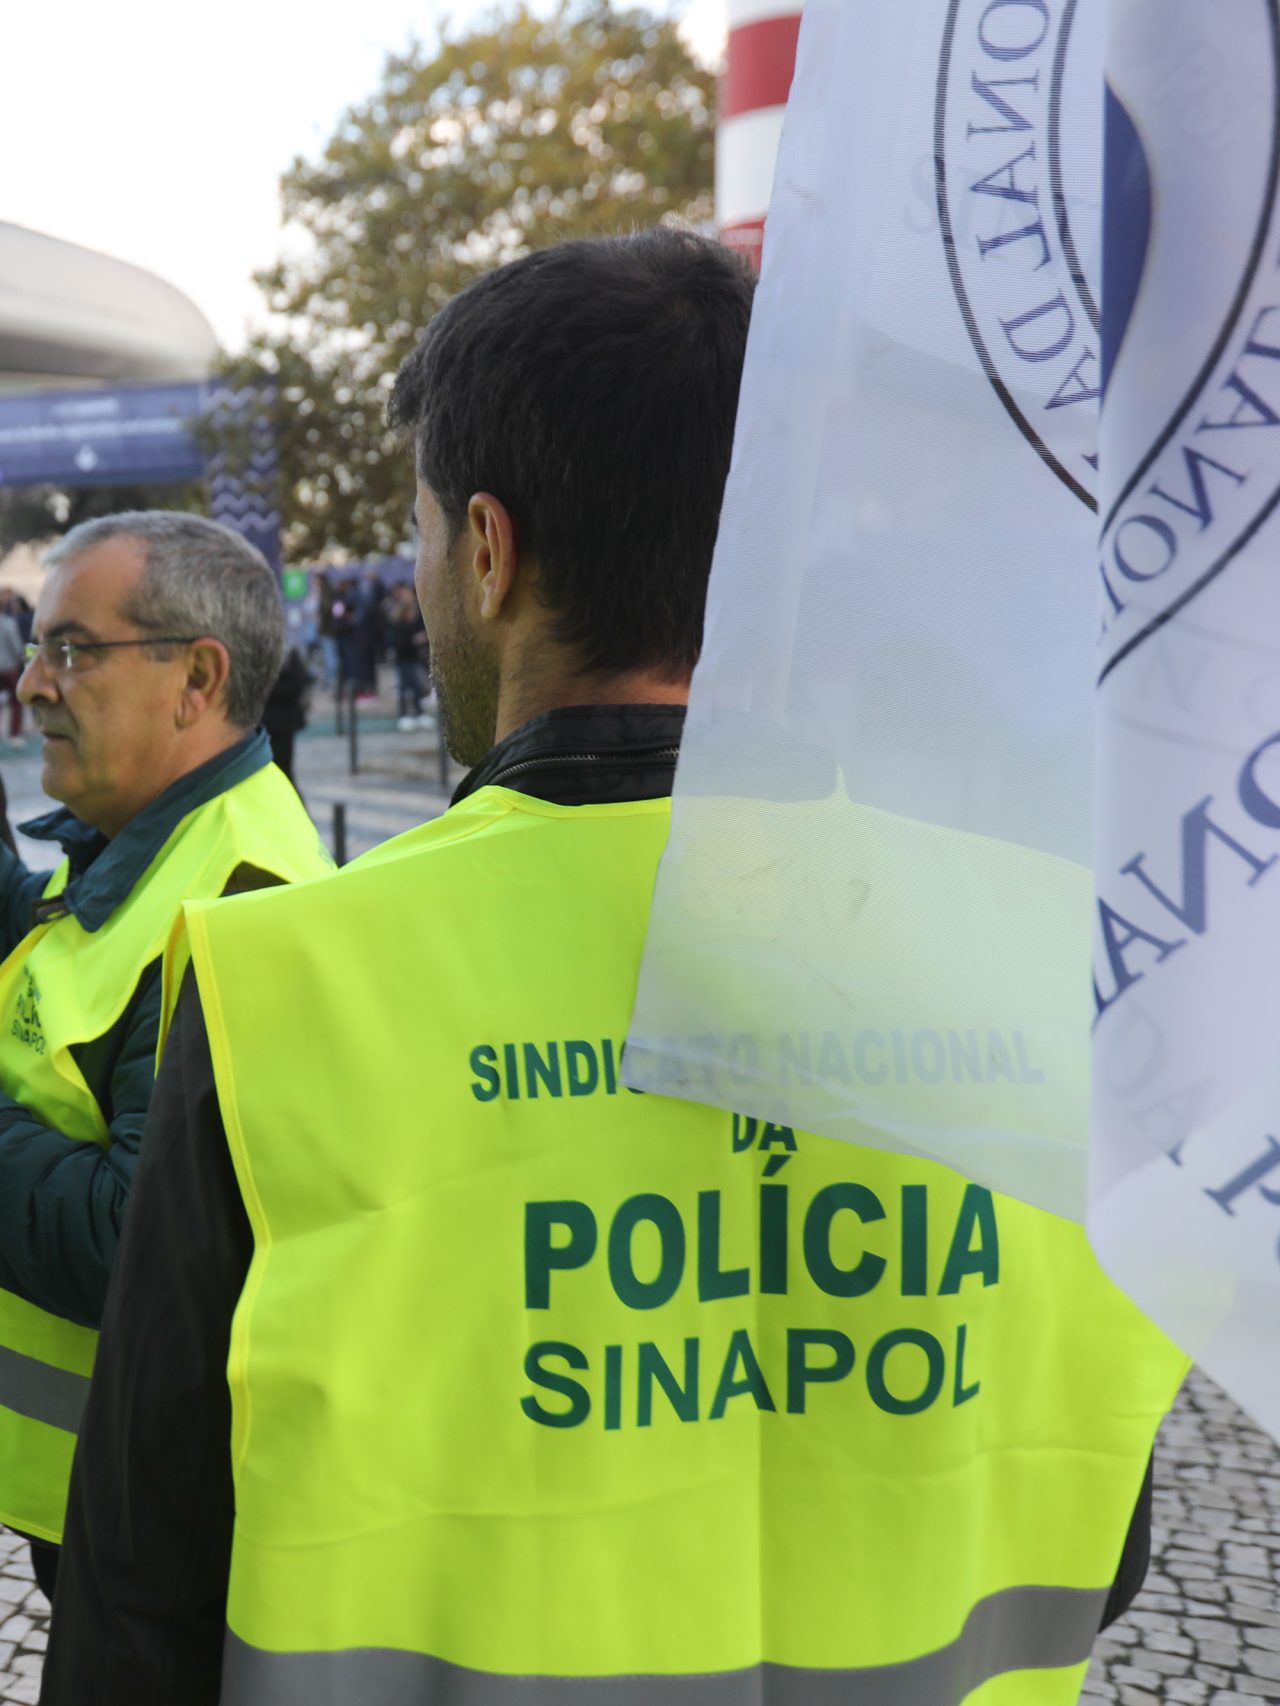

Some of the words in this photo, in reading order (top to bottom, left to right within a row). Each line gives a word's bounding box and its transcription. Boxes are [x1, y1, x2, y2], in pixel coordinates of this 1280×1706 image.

[468, 1033, 760, 1102] SINDICATO
[777, 1029, 1047, 1087] NACIONAL
[731, 1099, 799, 1154] DA
[524, 1154, 1000, 1311] POLÍCIA
[519, 1323, 982, 1432] SINAPOL
